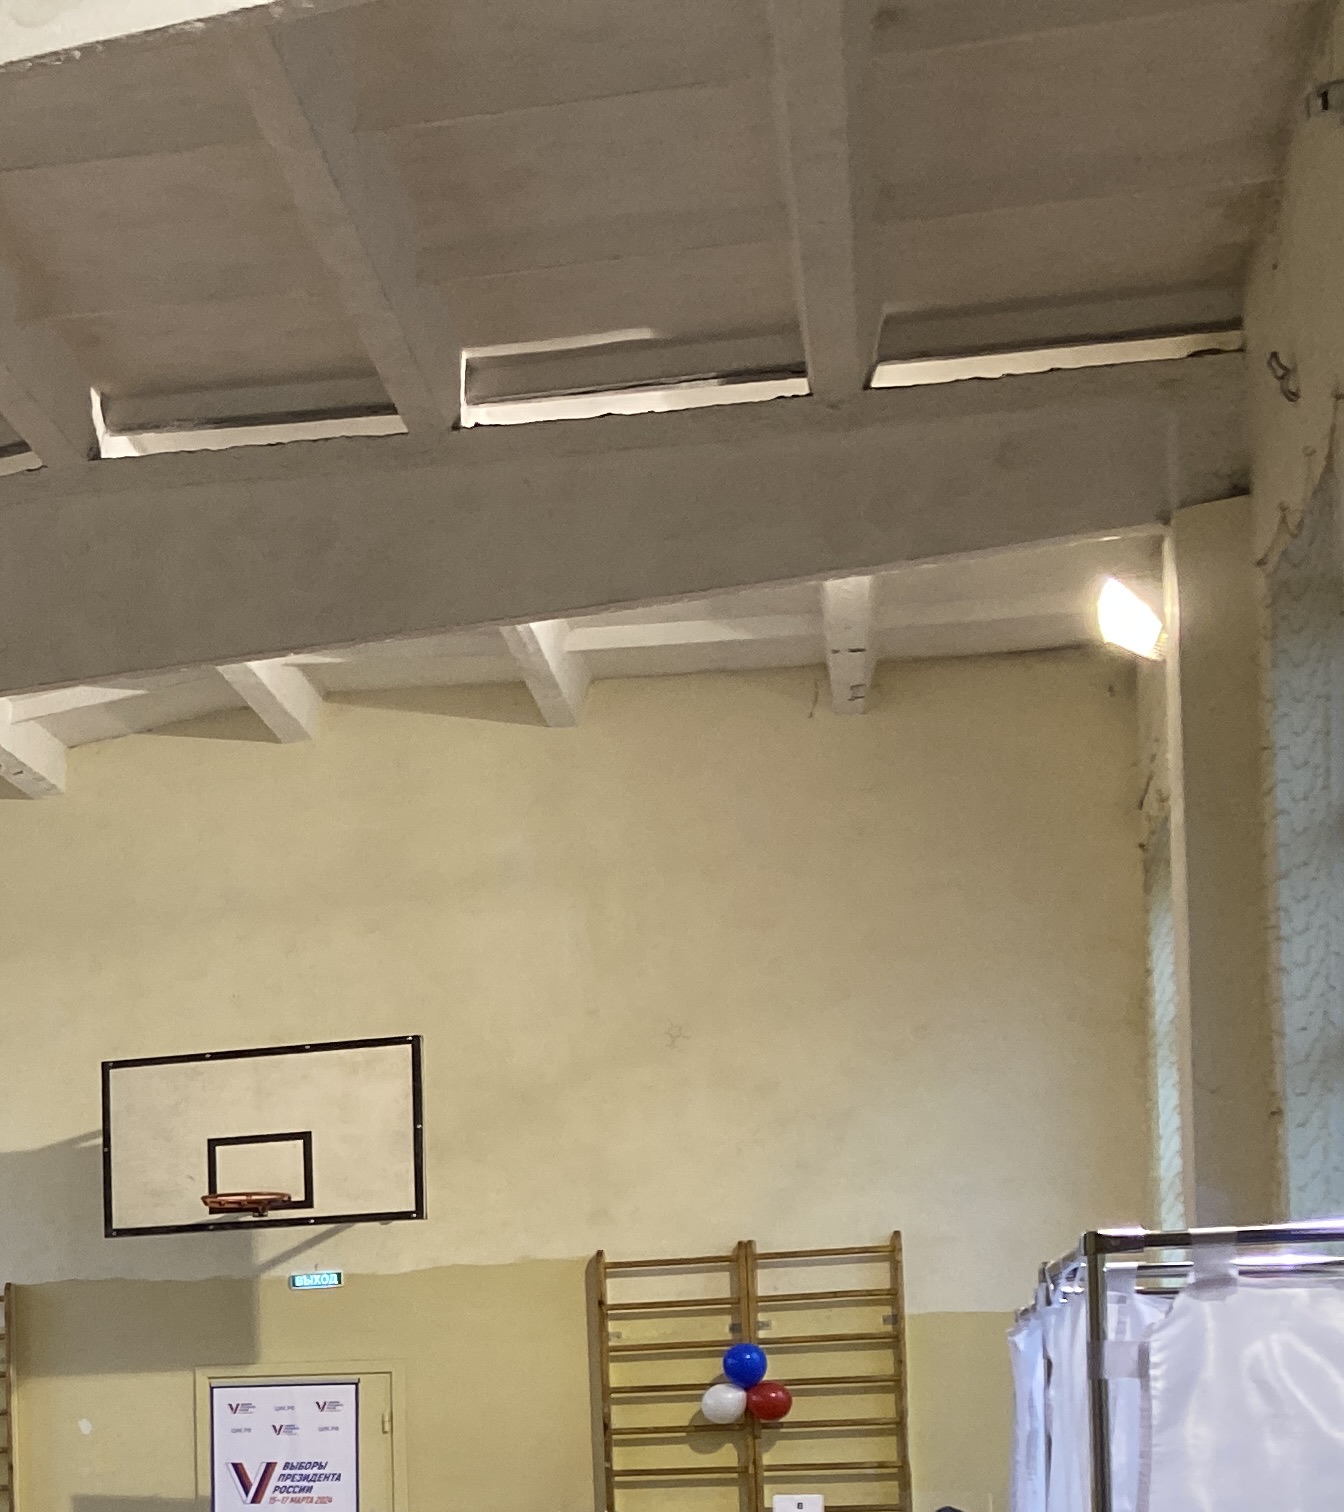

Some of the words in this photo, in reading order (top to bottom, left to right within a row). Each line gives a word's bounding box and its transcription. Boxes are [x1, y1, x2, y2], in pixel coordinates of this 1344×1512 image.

[295, 1273, 339, 1287] ВЫХОД
[282, 1461, 328, 1471] ВЫБОРЫ
[277, 1472, 342, 1482] ПРЕЗИДЕНТА
[272, 1485, 313, 1494] РОССИИ
